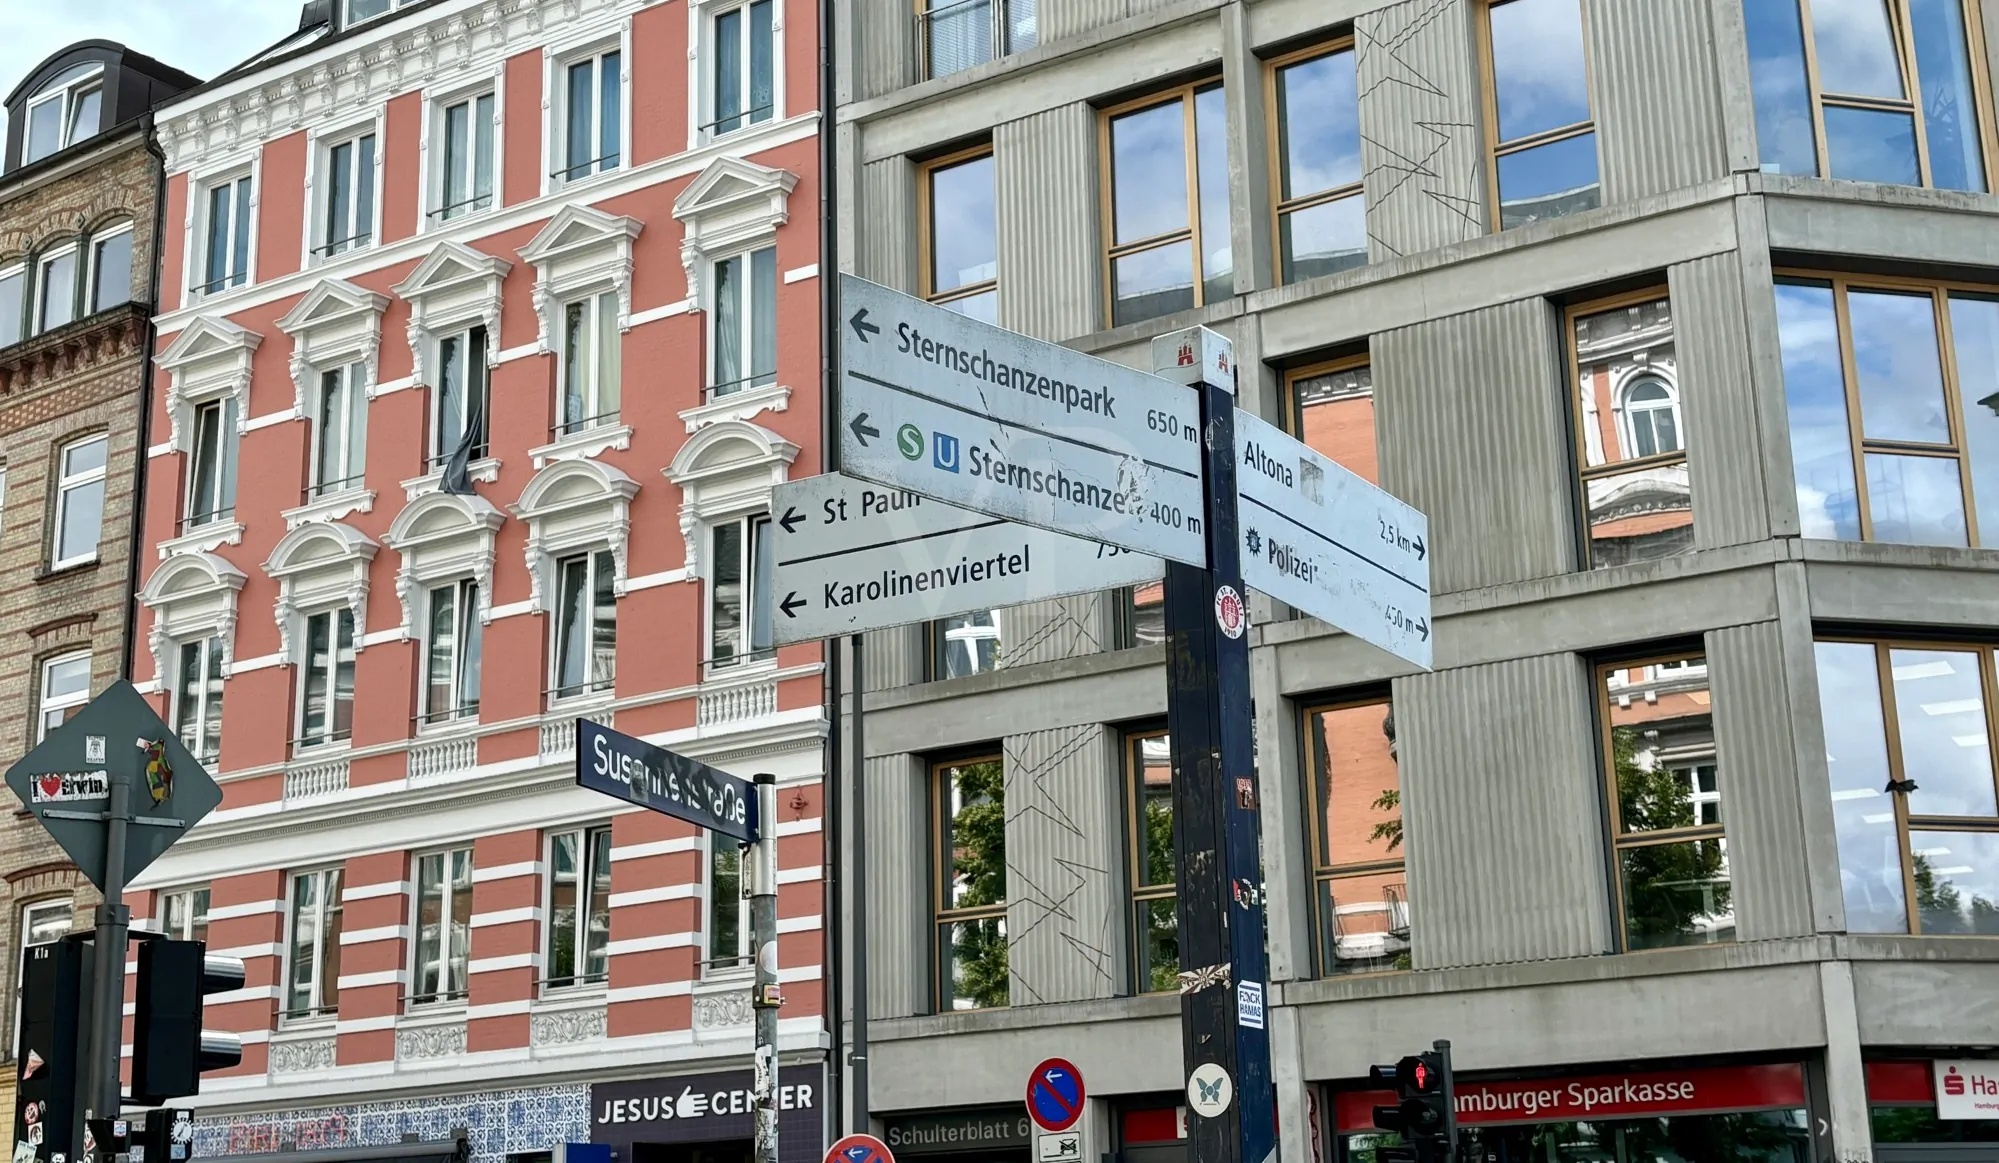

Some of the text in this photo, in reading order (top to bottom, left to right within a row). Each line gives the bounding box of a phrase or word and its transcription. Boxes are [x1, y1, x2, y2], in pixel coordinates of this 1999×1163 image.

[897, 322, 1117, 419] Sternschanzenpark
[1147, 408, 1178, 437] 650
[1183, 424, 1198, 444] m
[1244, 440, 1293, 489] Altona
[969, 446, 1126, 515] Sternschanze
[1150, 501, 1182, 529] 400
[1187, 515, 1202, 535] m
[823, 497, 848, 526] St
[1397, 528, 1411, 554] km
[824, 544, 1031, 610] Karolinenviertel
[1268, 537, 1314, 585] Polizei
[1405, 616, 1414, 635] m
[598, 1084, 813, 1125] JESUS CENER
[1454, 1078, 1695, 1115] mburger Sparkasse
[1971, 1074, 1999, 1096] Ha
[888, 1121, 1010, 1146] Schulterblatt
